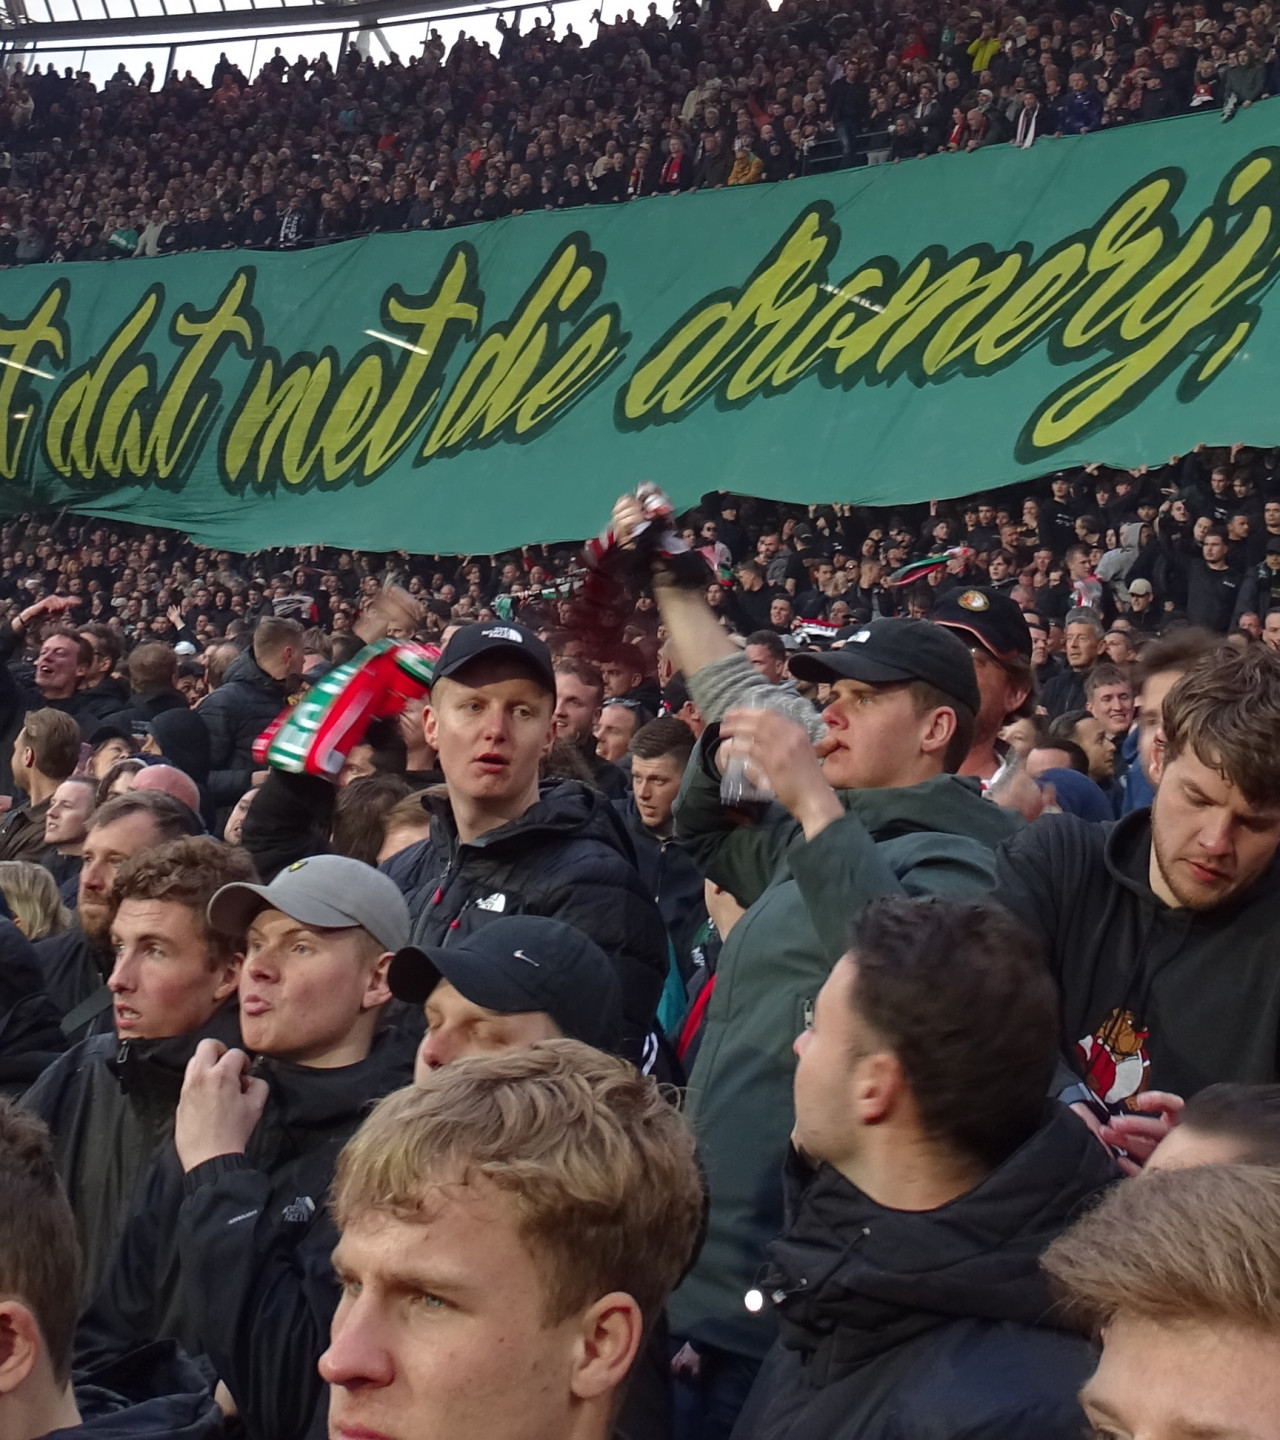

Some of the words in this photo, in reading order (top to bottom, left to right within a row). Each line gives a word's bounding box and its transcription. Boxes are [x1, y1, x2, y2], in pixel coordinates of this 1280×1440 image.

[45, 266, 261, 493] dat
[221, 242, 479, 498] met
[418, 231, 630, 465] die
